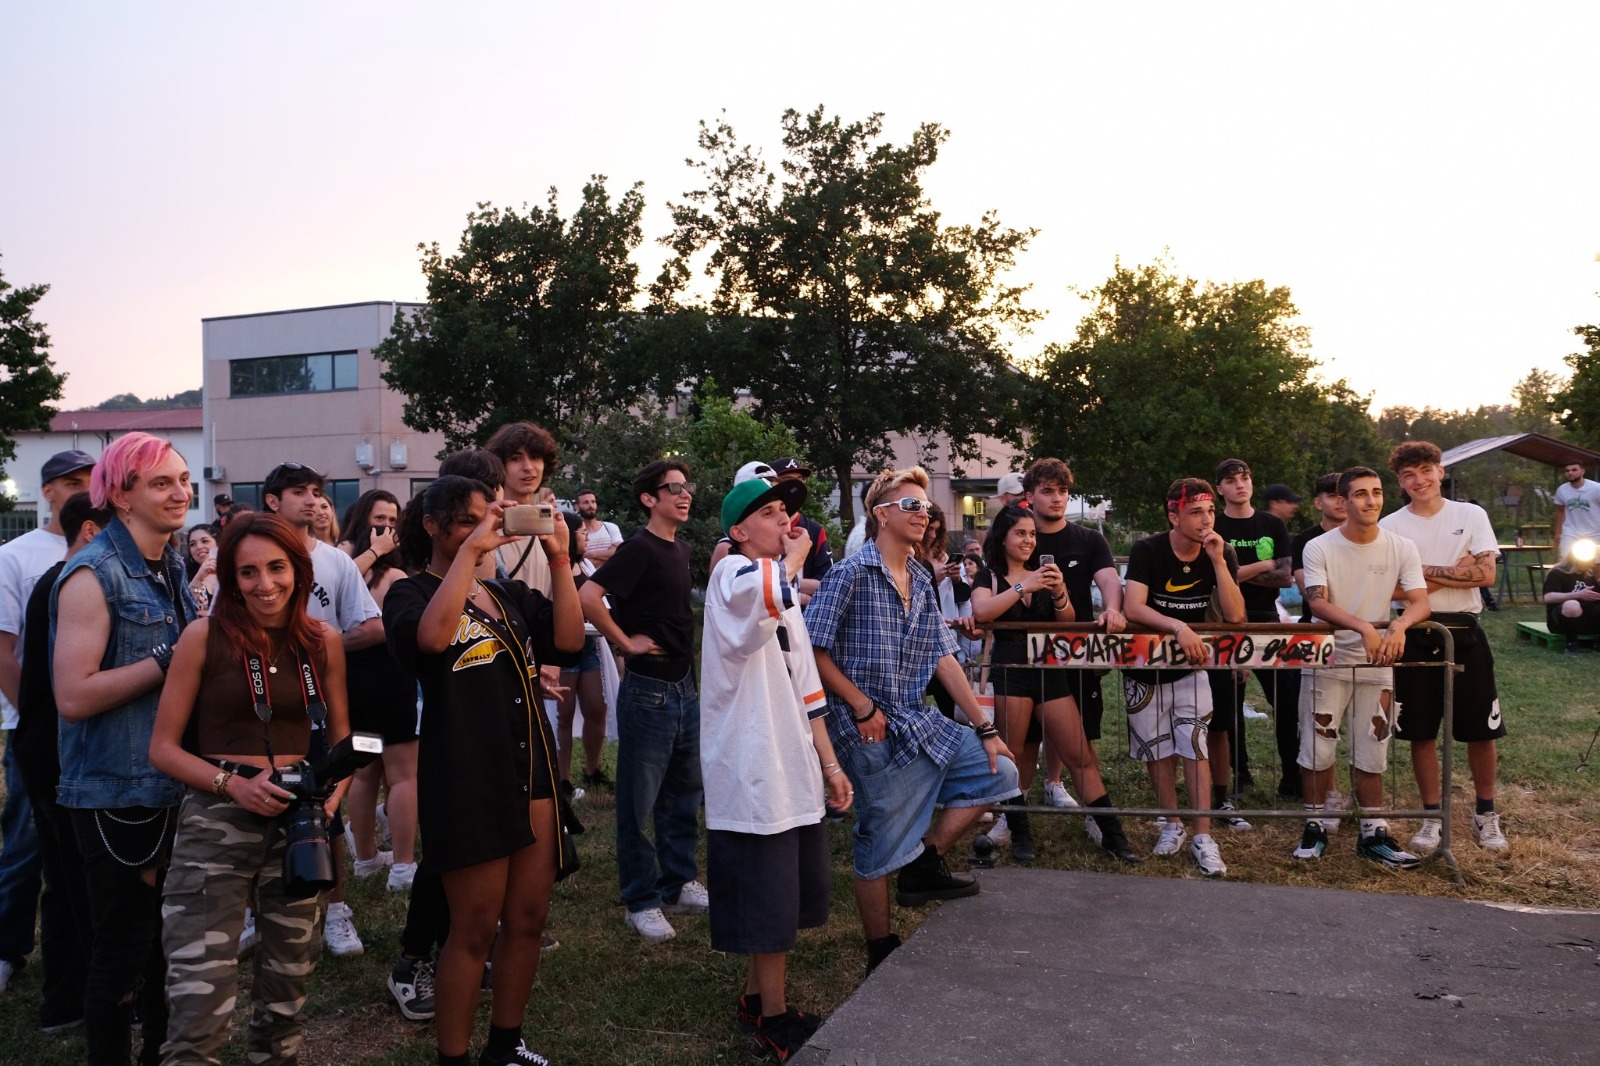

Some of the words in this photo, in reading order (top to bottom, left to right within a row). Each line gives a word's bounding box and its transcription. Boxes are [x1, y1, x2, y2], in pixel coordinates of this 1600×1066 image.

[1168, 601, 1209, 609] SPORTSWEA
[1031, 634, 1137, 664] LASCIARE
[1148, 634, 1254, 666] LIBRO
[250, 659, 260, 670] 6D
[252, 672, 263, 694] EOS
[302, 664, 316, 695] Canon
